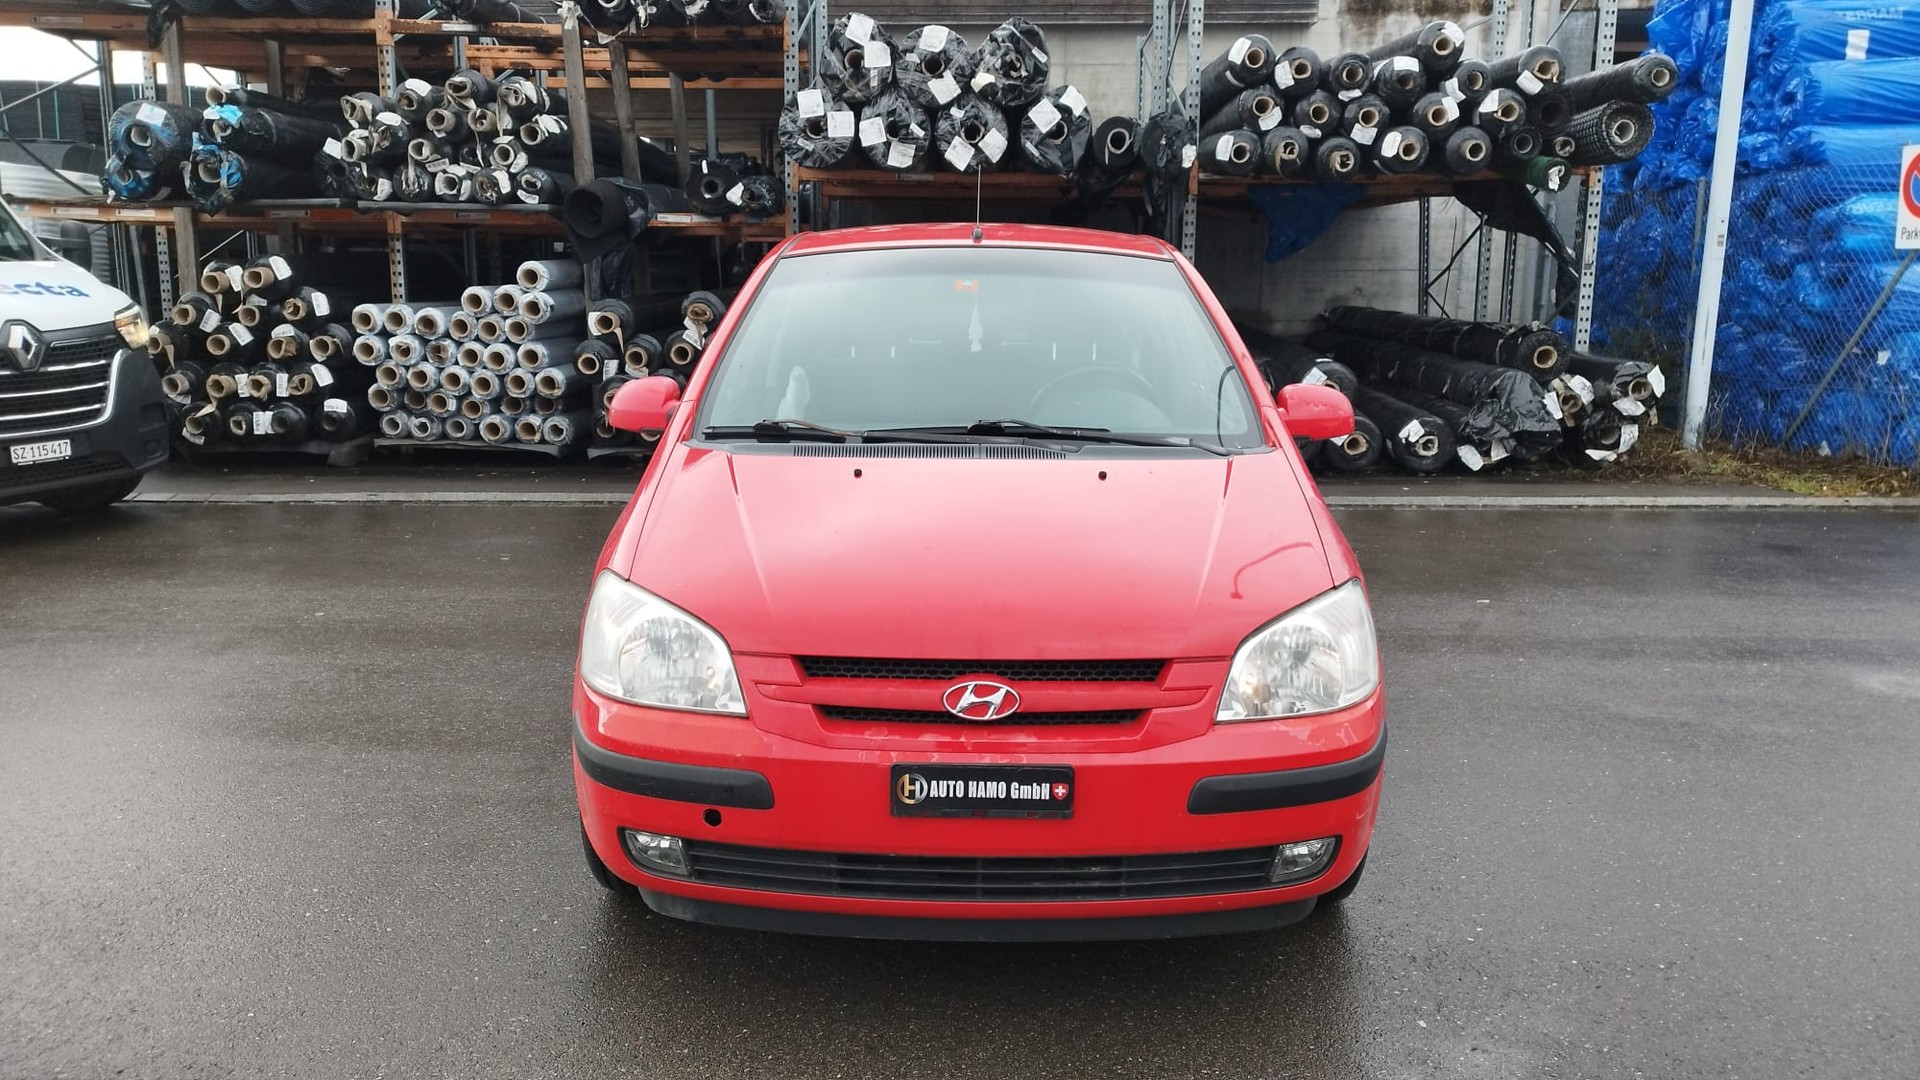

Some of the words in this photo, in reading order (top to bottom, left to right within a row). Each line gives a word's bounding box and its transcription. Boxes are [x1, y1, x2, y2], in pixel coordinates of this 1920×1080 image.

[12, 446, 27, 460] SZ
[929, 780, 965, 798] AUTO
[968, 781, 1007, 799] HAMO
[1010, 782, 1051, 800] GmbH
